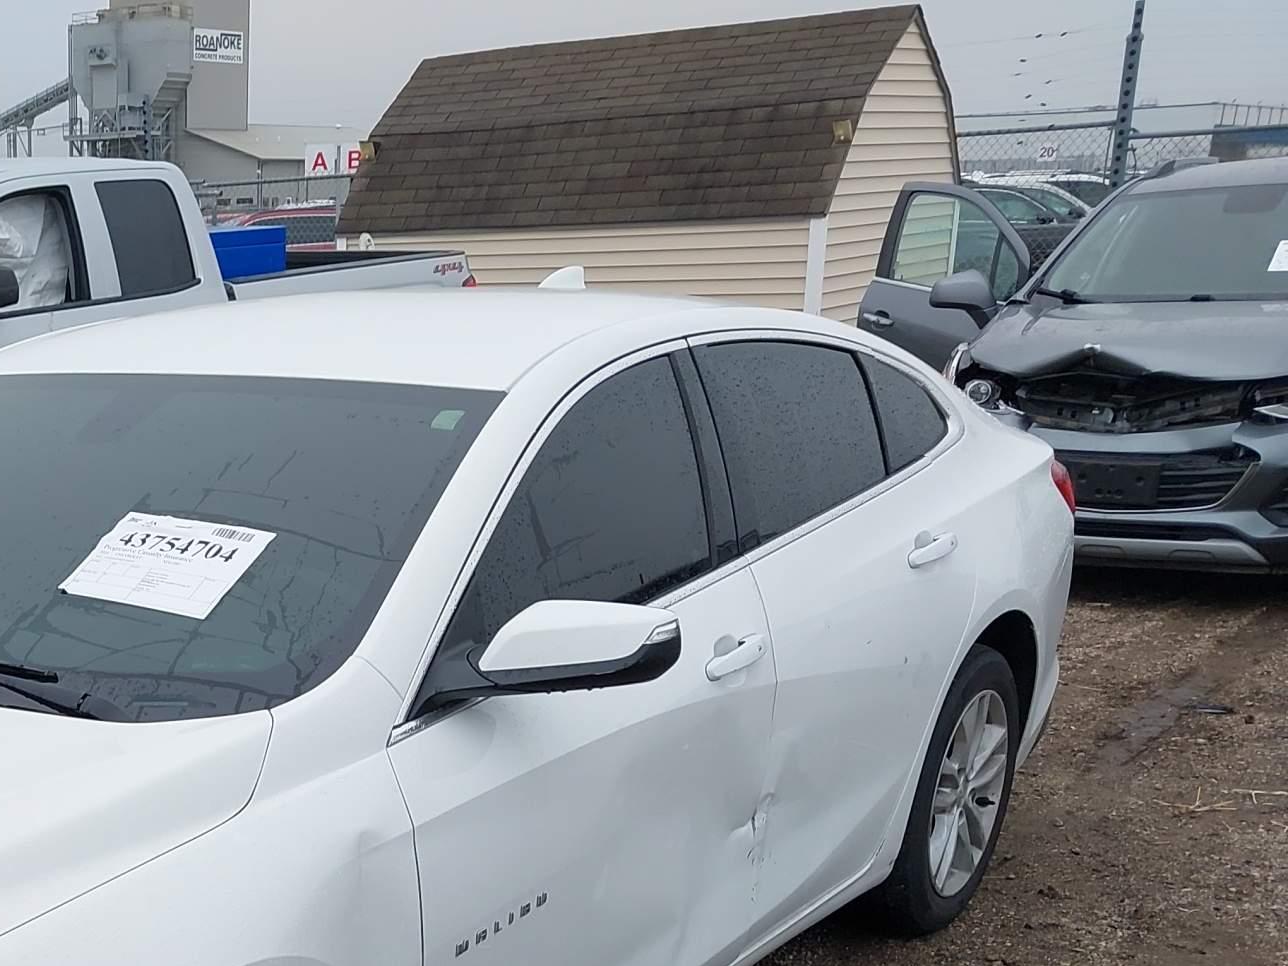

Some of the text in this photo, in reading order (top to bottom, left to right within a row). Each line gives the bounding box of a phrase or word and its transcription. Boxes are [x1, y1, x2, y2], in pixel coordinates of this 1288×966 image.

[195, 33, 241, 51] ROANOKE
[195, 52, 242, 62] CONCRETE PRODUCTS
[348, 150, 362, 169] B
[1039, 146, 1054, 158] 20
[312, 152, 328, 171] A
[119, 531, 239, 563] 43754704
